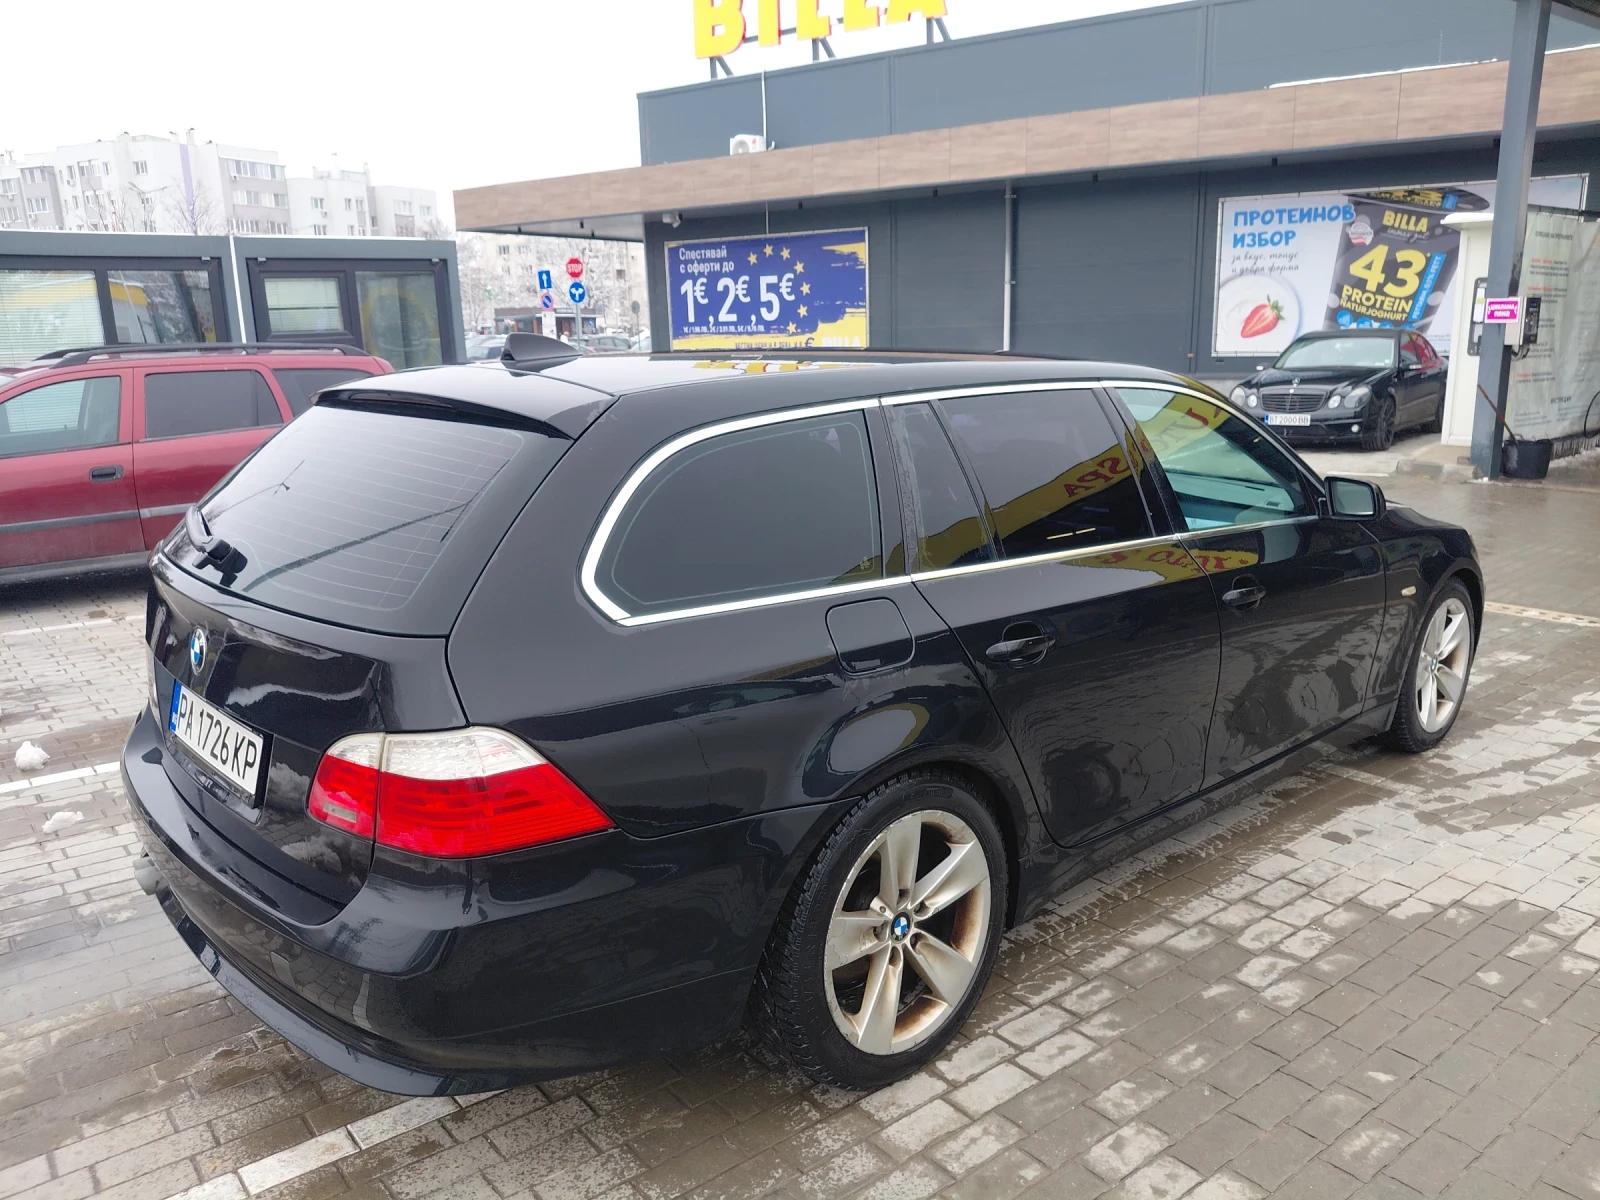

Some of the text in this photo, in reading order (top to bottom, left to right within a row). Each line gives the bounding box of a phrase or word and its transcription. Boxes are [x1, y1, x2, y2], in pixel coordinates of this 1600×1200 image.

[1233, 203, 1356, 227] ПРОТЕИНОВ
[1382, 209, 1428, 232] BILLA
[1232, 230, 1296, 249] ИЗБОР
[679, 245, 727, 260] Спестявай
[567, 263, 582, 273] STOP
[679, 260, 735, 276] с оферти до
[1341, 284, 1413, 313] PROTEIN
[1340, 299, 1408, 321] NATURJOGHURT
